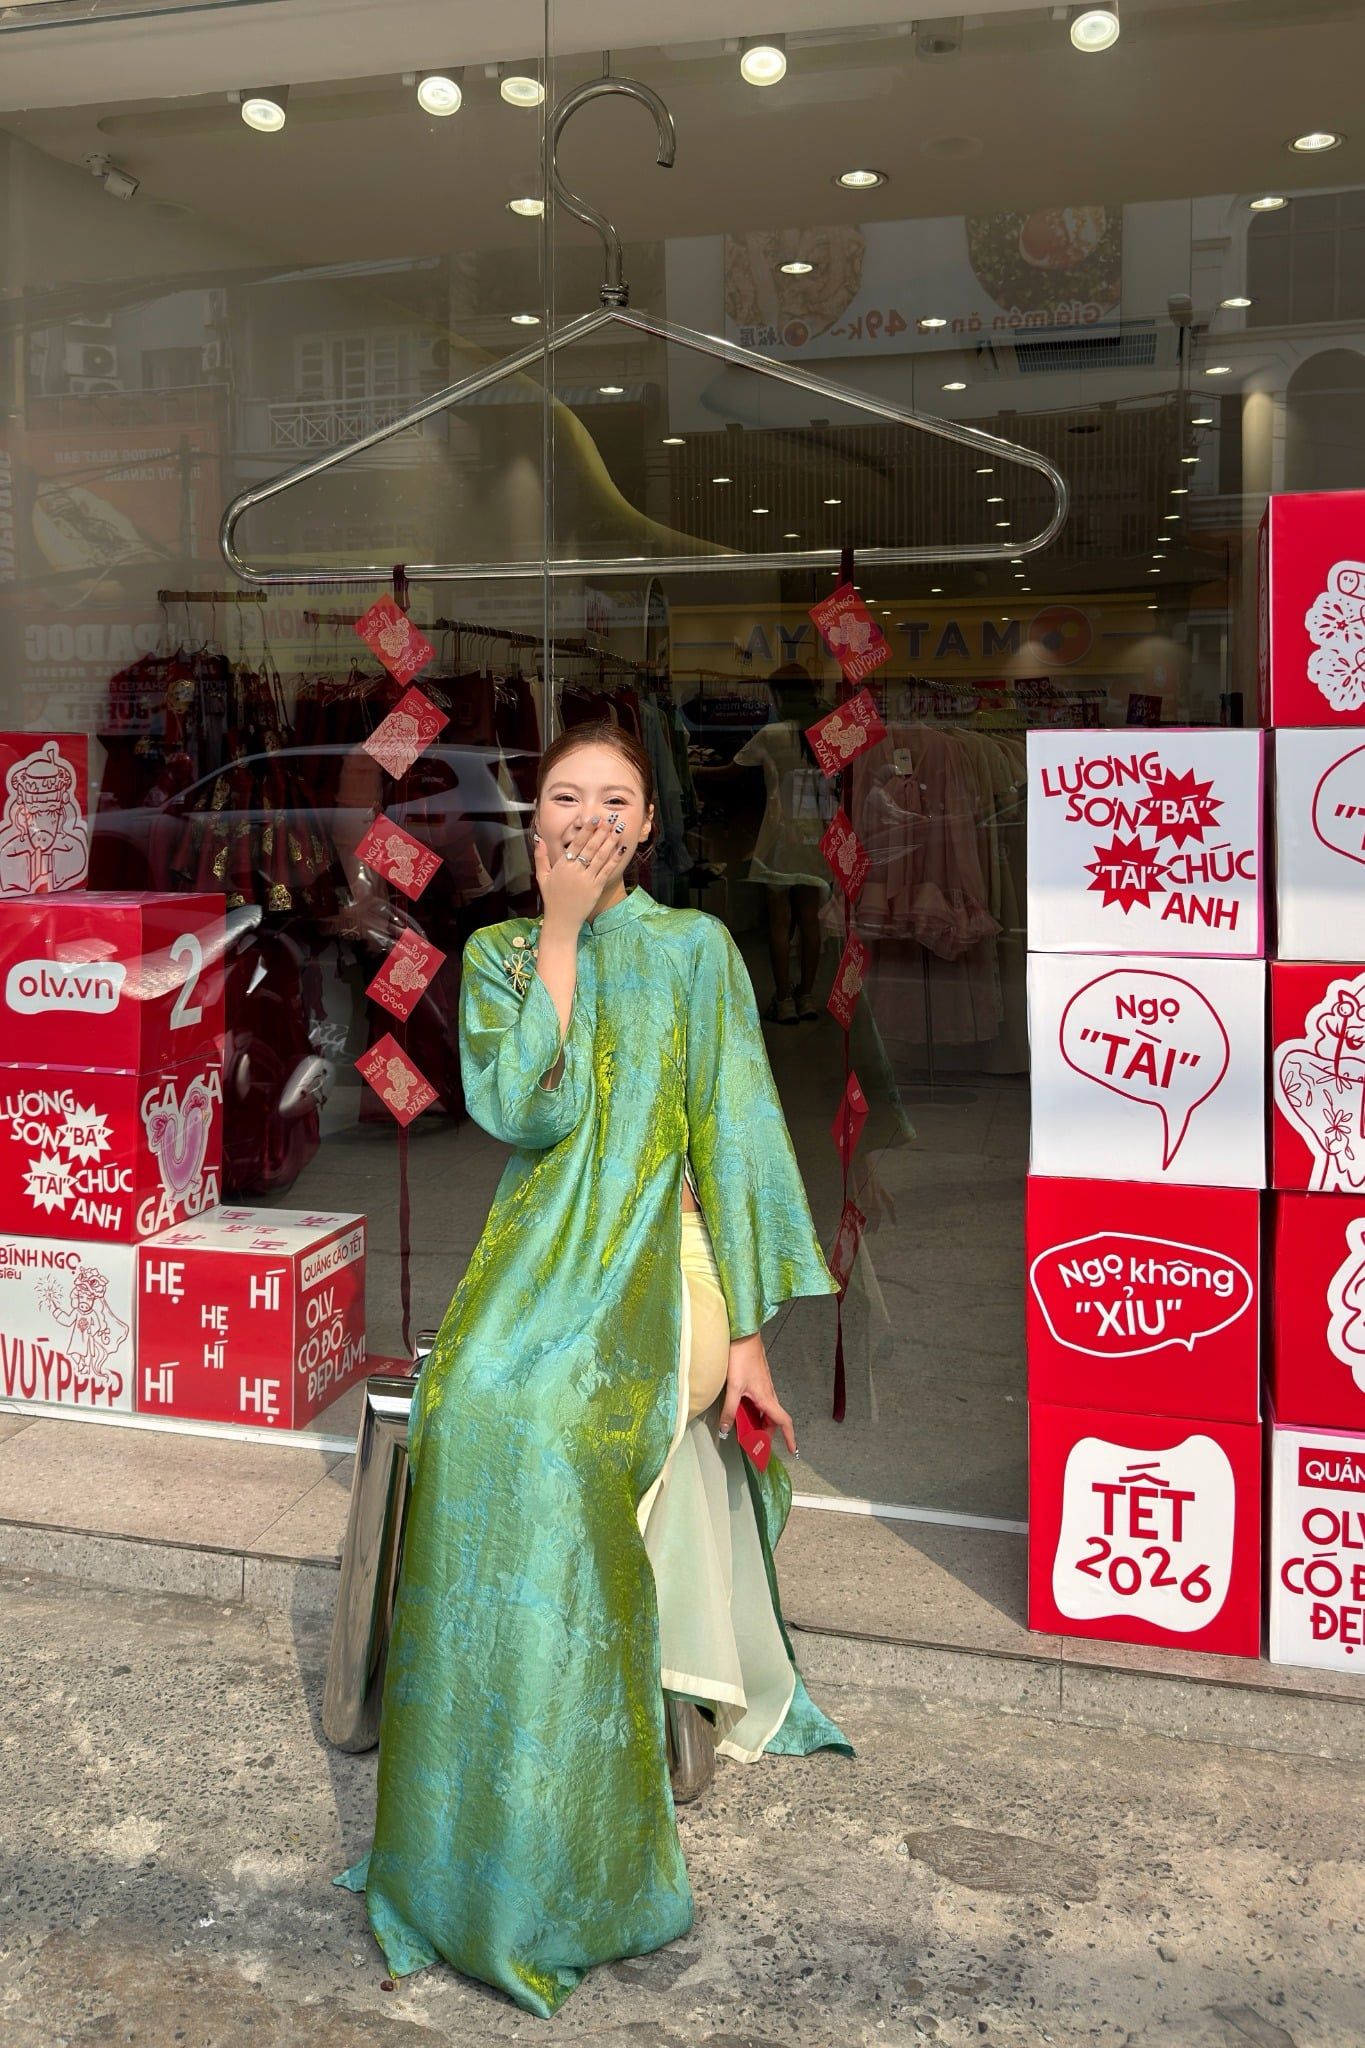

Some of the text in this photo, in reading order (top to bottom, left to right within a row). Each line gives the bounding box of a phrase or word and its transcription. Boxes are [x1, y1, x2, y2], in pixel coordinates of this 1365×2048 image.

[1041, 751, 1162, 798] LƯƠNG
[1065, 793, 1211, 834] SƠN "BÁ"
[1094, 843, 1256, 890] "TÀI" CHÚC
[1161, 892, 1239, 930] ANH
[18, 968, 114, 1000] olv.vn
[169, 933, 204, 1031] 2
[1115, 994, 1180, 1025] Ngọ
[1080, 1028, 1201, 1089] "TÀI"
[0, 1088, 76, 1121] LƯƠNG
[10, 1118, 106, 1153] SƠN "BÁ"
[28, 1162, 134, 1197] "TÀI" CHÚC
[71, 1198, 122, 1231] ANH
[304, 1231, 362, 1282] QUẢNG CÁO TẾT
[1057, 1253, 1234, 1298] Ngọ không
[146, 1260, 185, 1304] HẸ
[250, 1268, 286, 1310] HÍ
[201, 1304, 229, 1336] HẸ
[306, 1286, 334, 1329] OLV
[1075, 1286, 1183, 1337] "XỈU"
[203, 1340, 229, 1369] HÍ
[298, 1308, 344, 1374] CÓ ĐỒ
[145, 1361, 180, 1404] HÍ
[307, 1332, 366, 1403] ĐẸP LẮM!
[240, 1376, 280, 1424] HẸ
[1092, 1462, 1195, 1543] TẾT
[1074, 1536, 1211, 1604] 2026
[1280, 1552, 1343, 1598] CÓ
